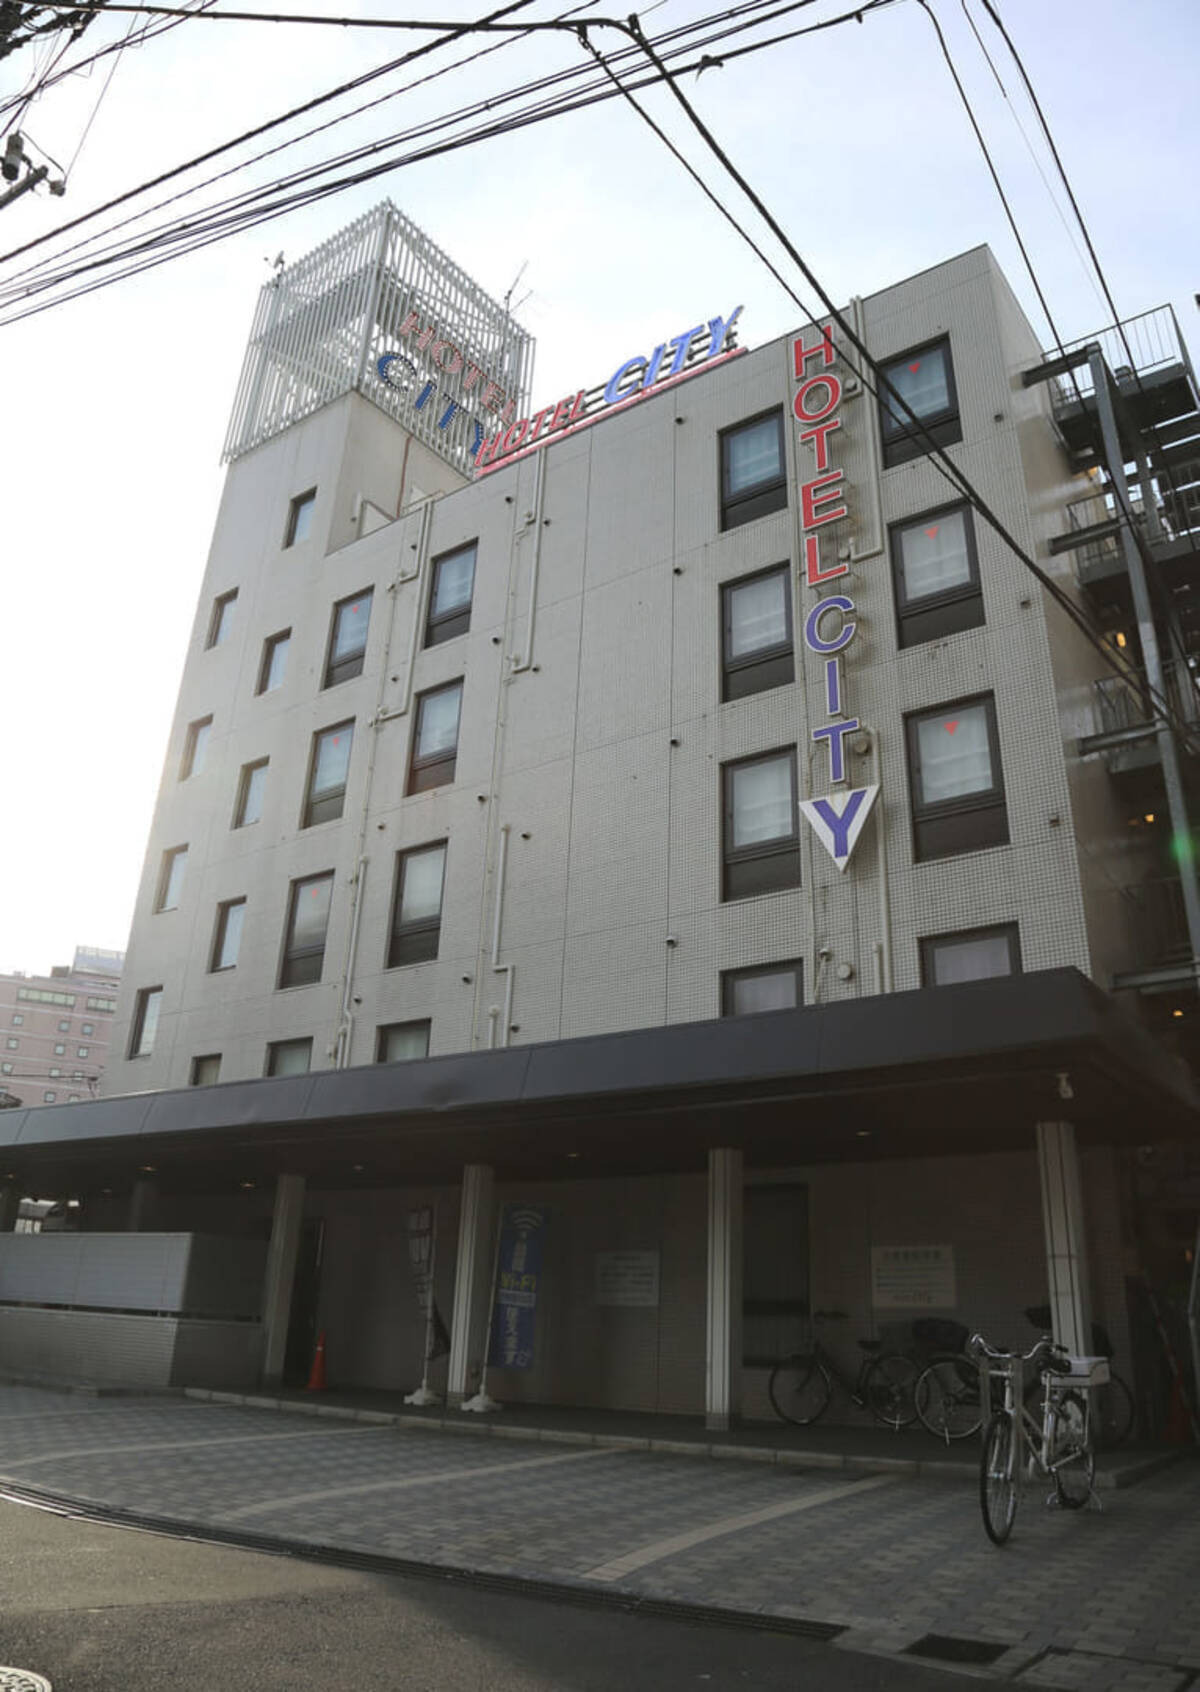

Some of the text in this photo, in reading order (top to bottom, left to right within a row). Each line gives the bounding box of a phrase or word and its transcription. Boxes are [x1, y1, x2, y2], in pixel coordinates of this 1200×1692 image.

[400, 311, 516, 426] HOTEL
[473, 305, 745, 466] HOTEL CITY
[792, 324, 868, 860] HOTEL CITY
